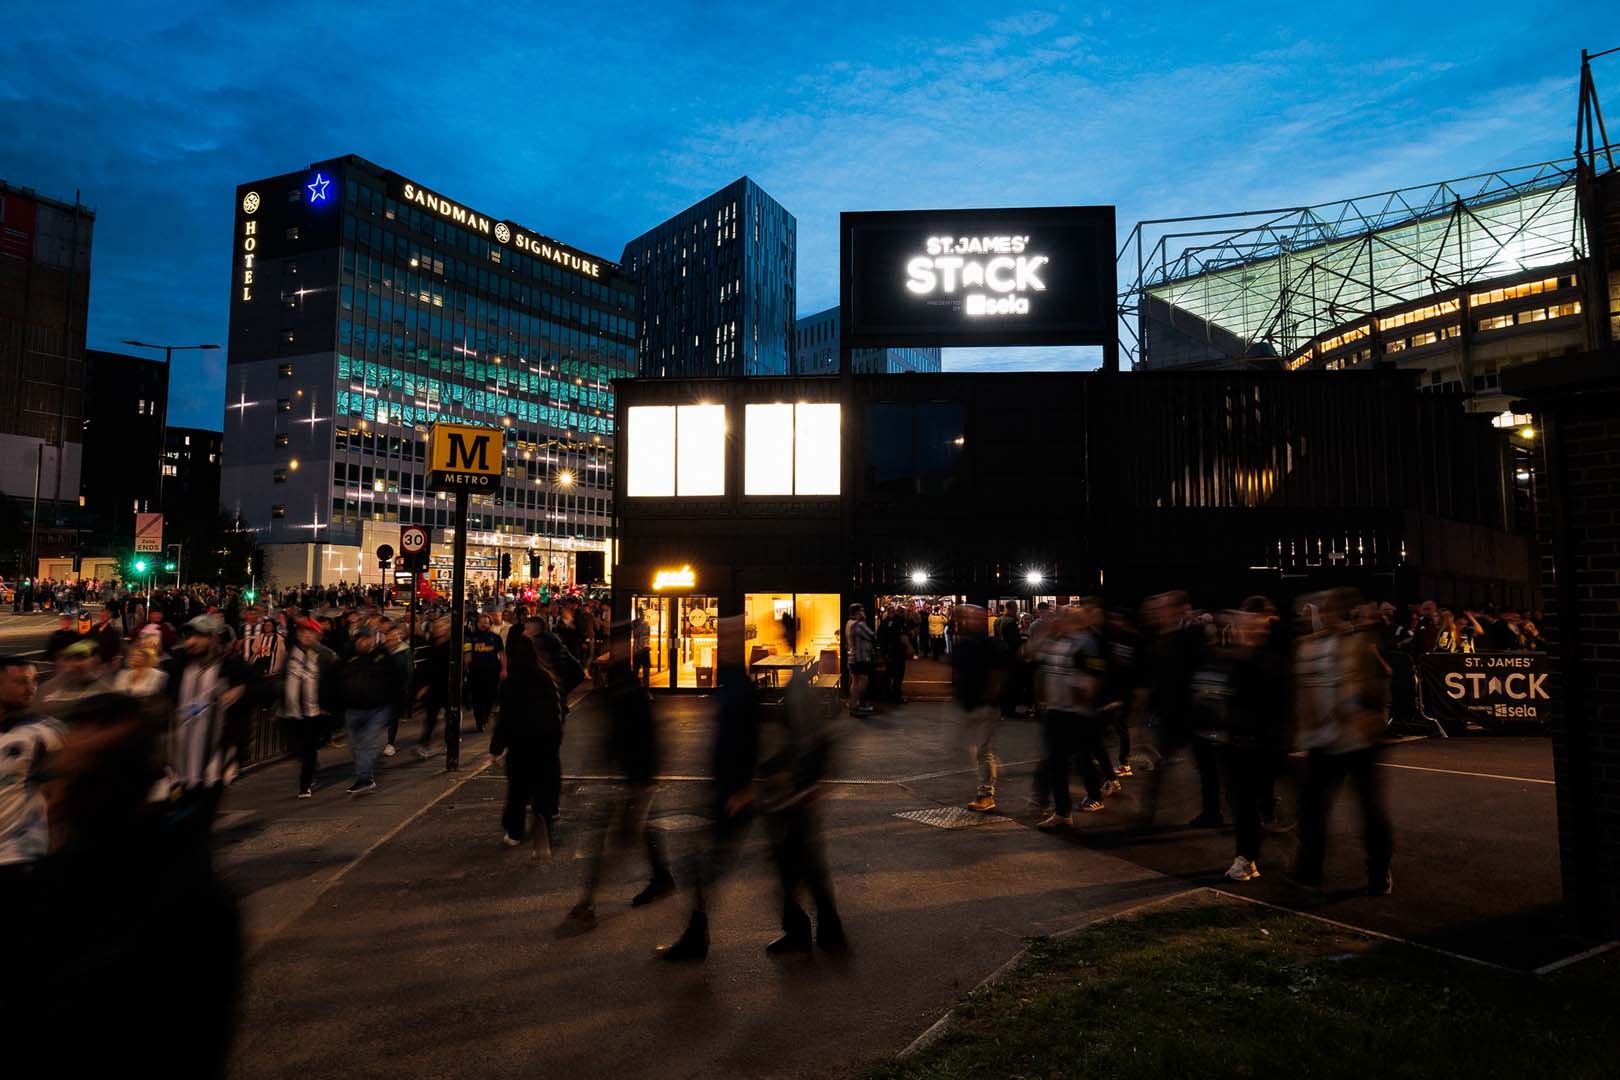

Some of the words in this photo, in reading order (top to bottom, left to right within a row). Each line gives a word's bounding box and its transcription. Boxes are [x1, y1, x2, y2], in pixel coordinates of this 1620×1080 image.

[404, 184, 489, 233] SANDMAN
[515, 233, 600, 278] SIGNATURE
[243, 221, 256, 301] HOTEL
[446, 433, 490, 471] M
[444, 474, 489, 485] METRO
[404, 534, 423, 546] 30
[1464, 657, 1484, 667] ST.
[1508, 704, 1537, 718] sela
